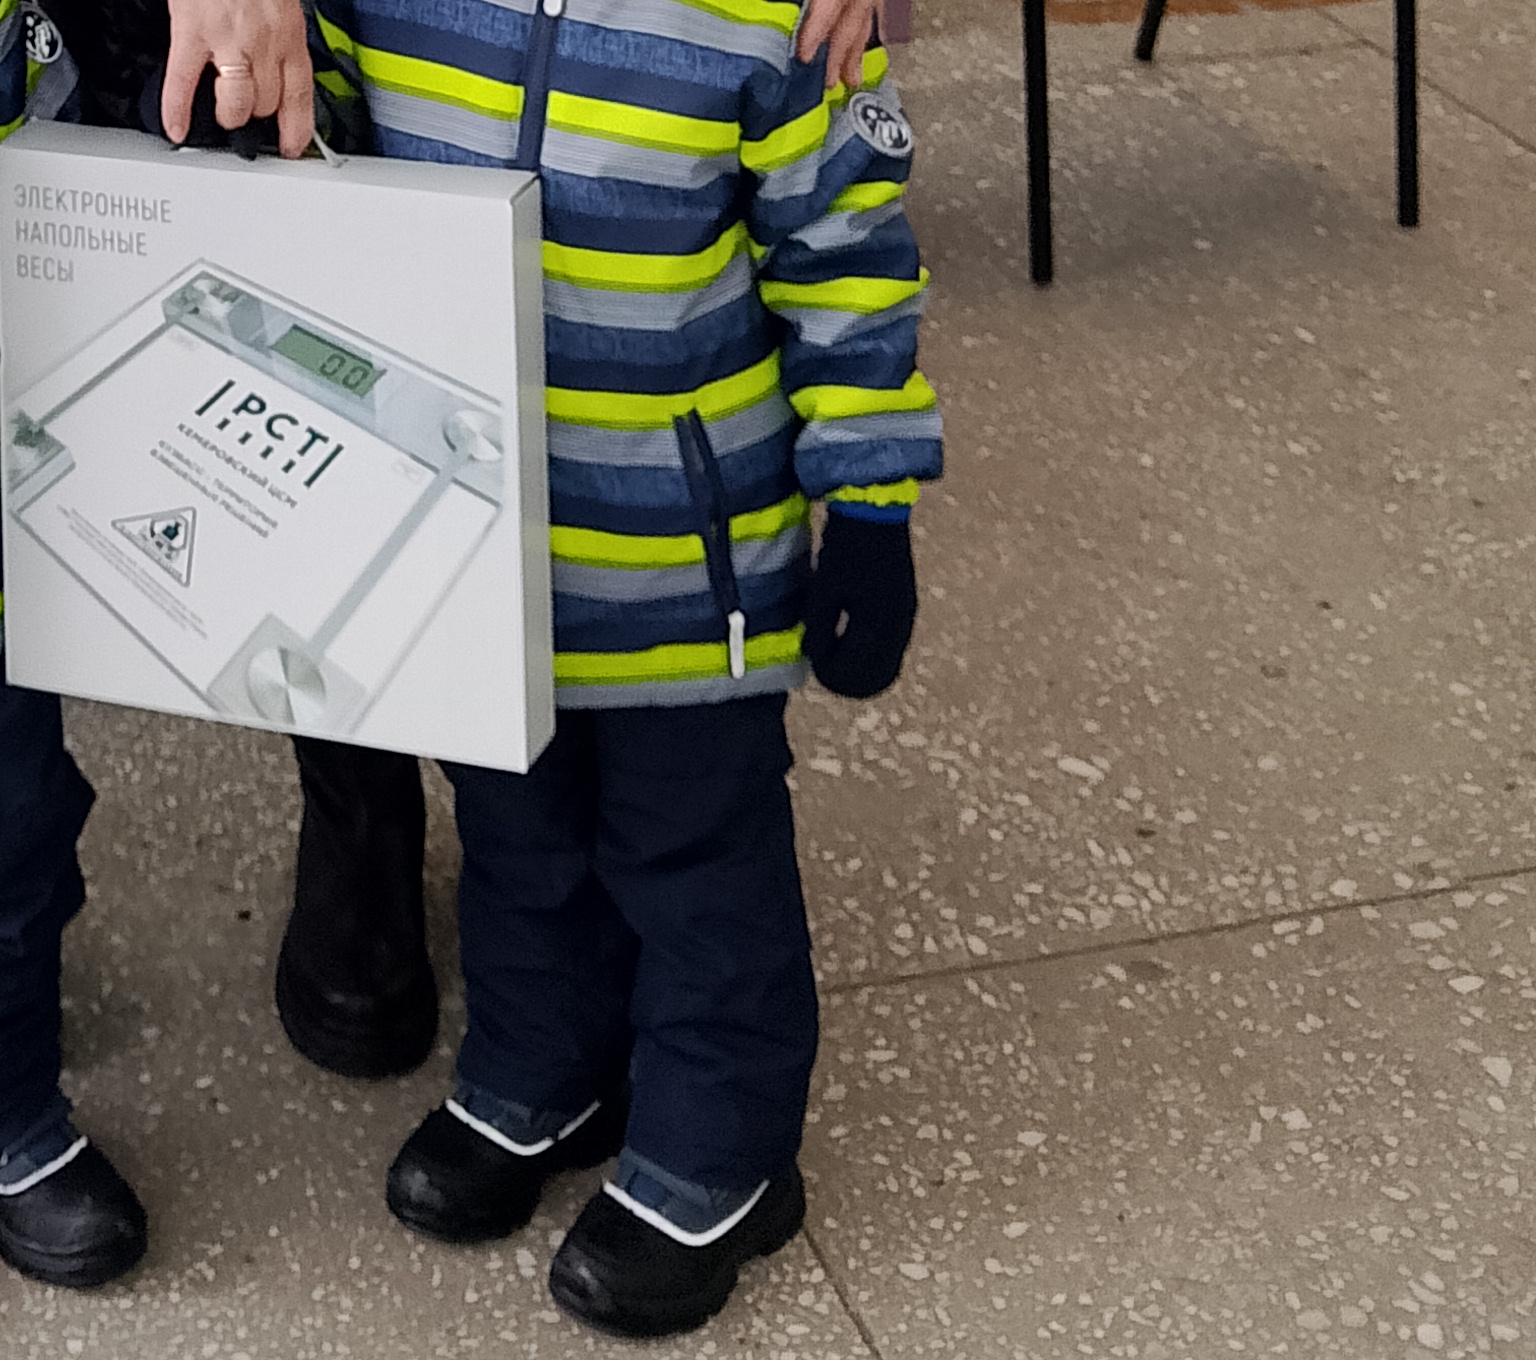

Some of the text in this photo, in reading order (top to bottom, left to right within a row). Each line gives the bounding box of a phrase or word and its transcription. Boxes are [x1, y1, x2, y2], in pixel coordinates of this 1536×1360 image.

[14, 183, 172, 223] ЭЛЕКТРОННЫЕ
[15, 218, 147, 256] НАПОЛЬНЫЕ
[16, 254, 74, 281] ВЕСЫ
